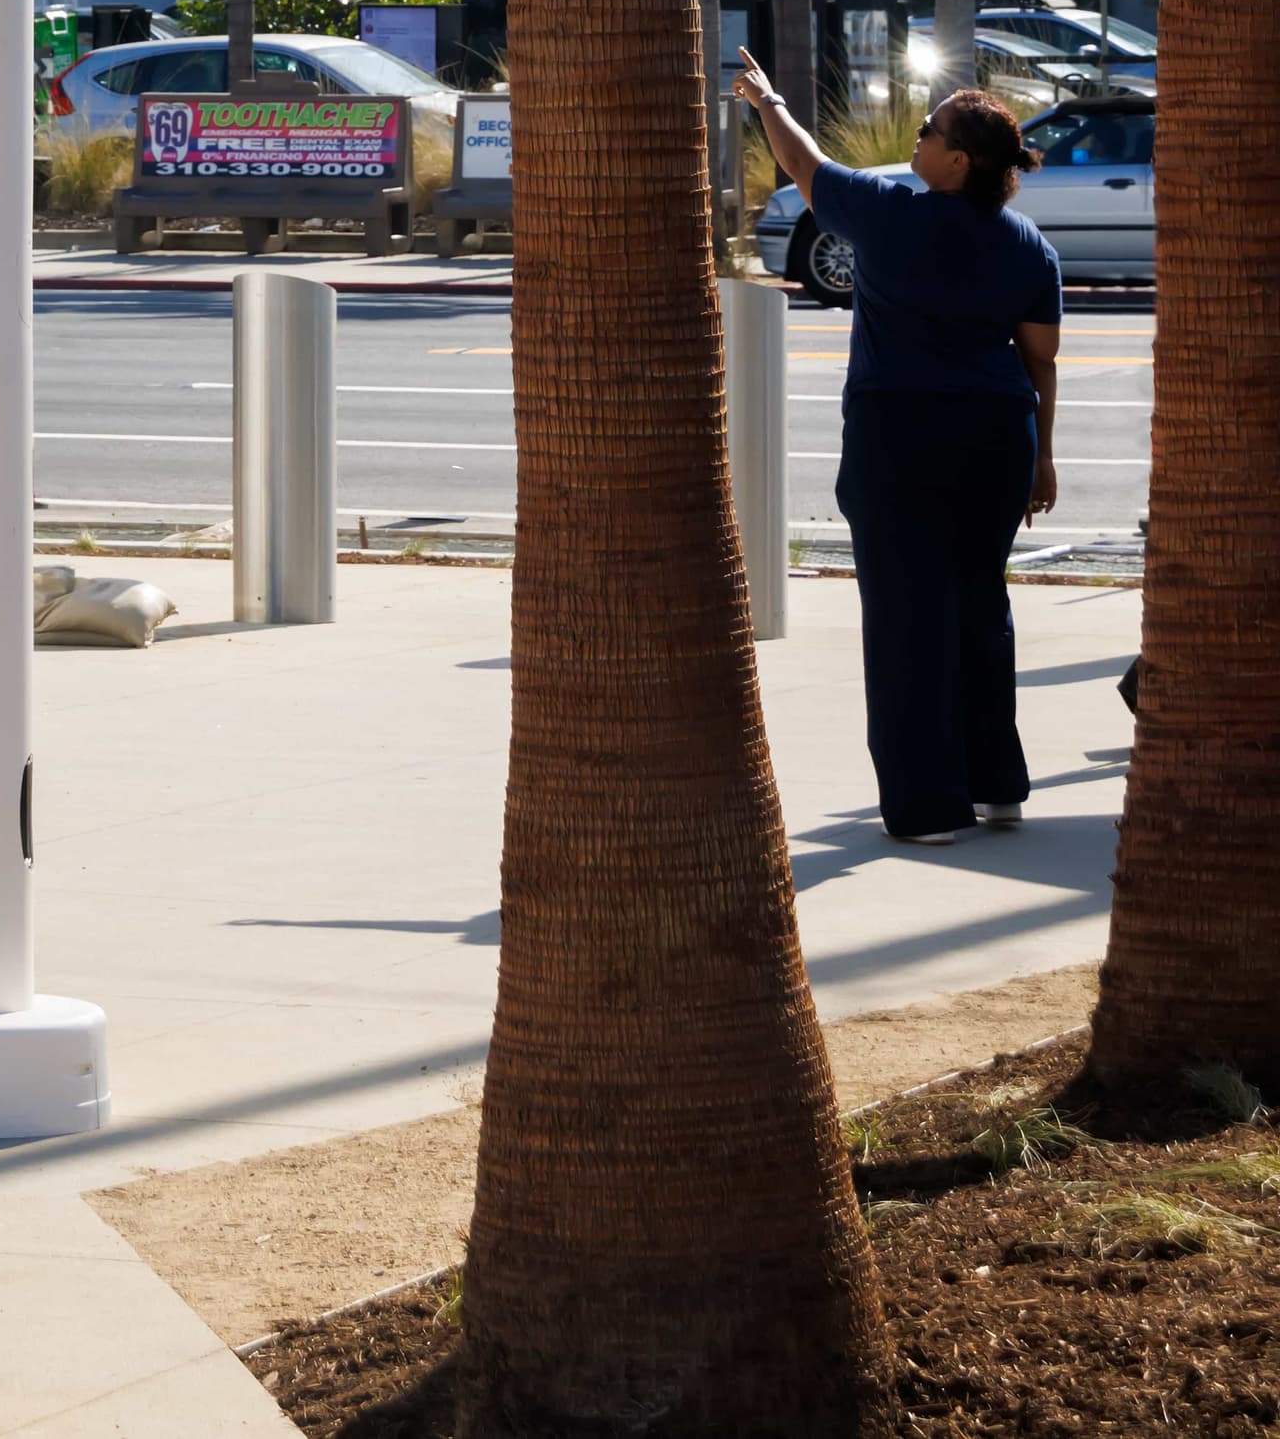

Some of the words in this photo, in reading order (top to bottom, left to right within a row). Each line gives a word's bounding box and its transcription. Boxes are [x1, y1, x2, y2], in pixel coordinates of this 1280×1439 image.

[198, 102, 394, 128] TOOTHACHE?
[201, 129, 282, 137] EMERGENCY
[354, 129, 382, 137] PPO
[197, 138, 287, 151] FREE
[466, 136, 512, 147] OFFIC
[202, 153, 223, 161] 0%
[226, 153, 303, 161] FINANCING
[306, 153, 381, 161] AVAILABLE
[155, 162, 384, 176] 310-330-9000
